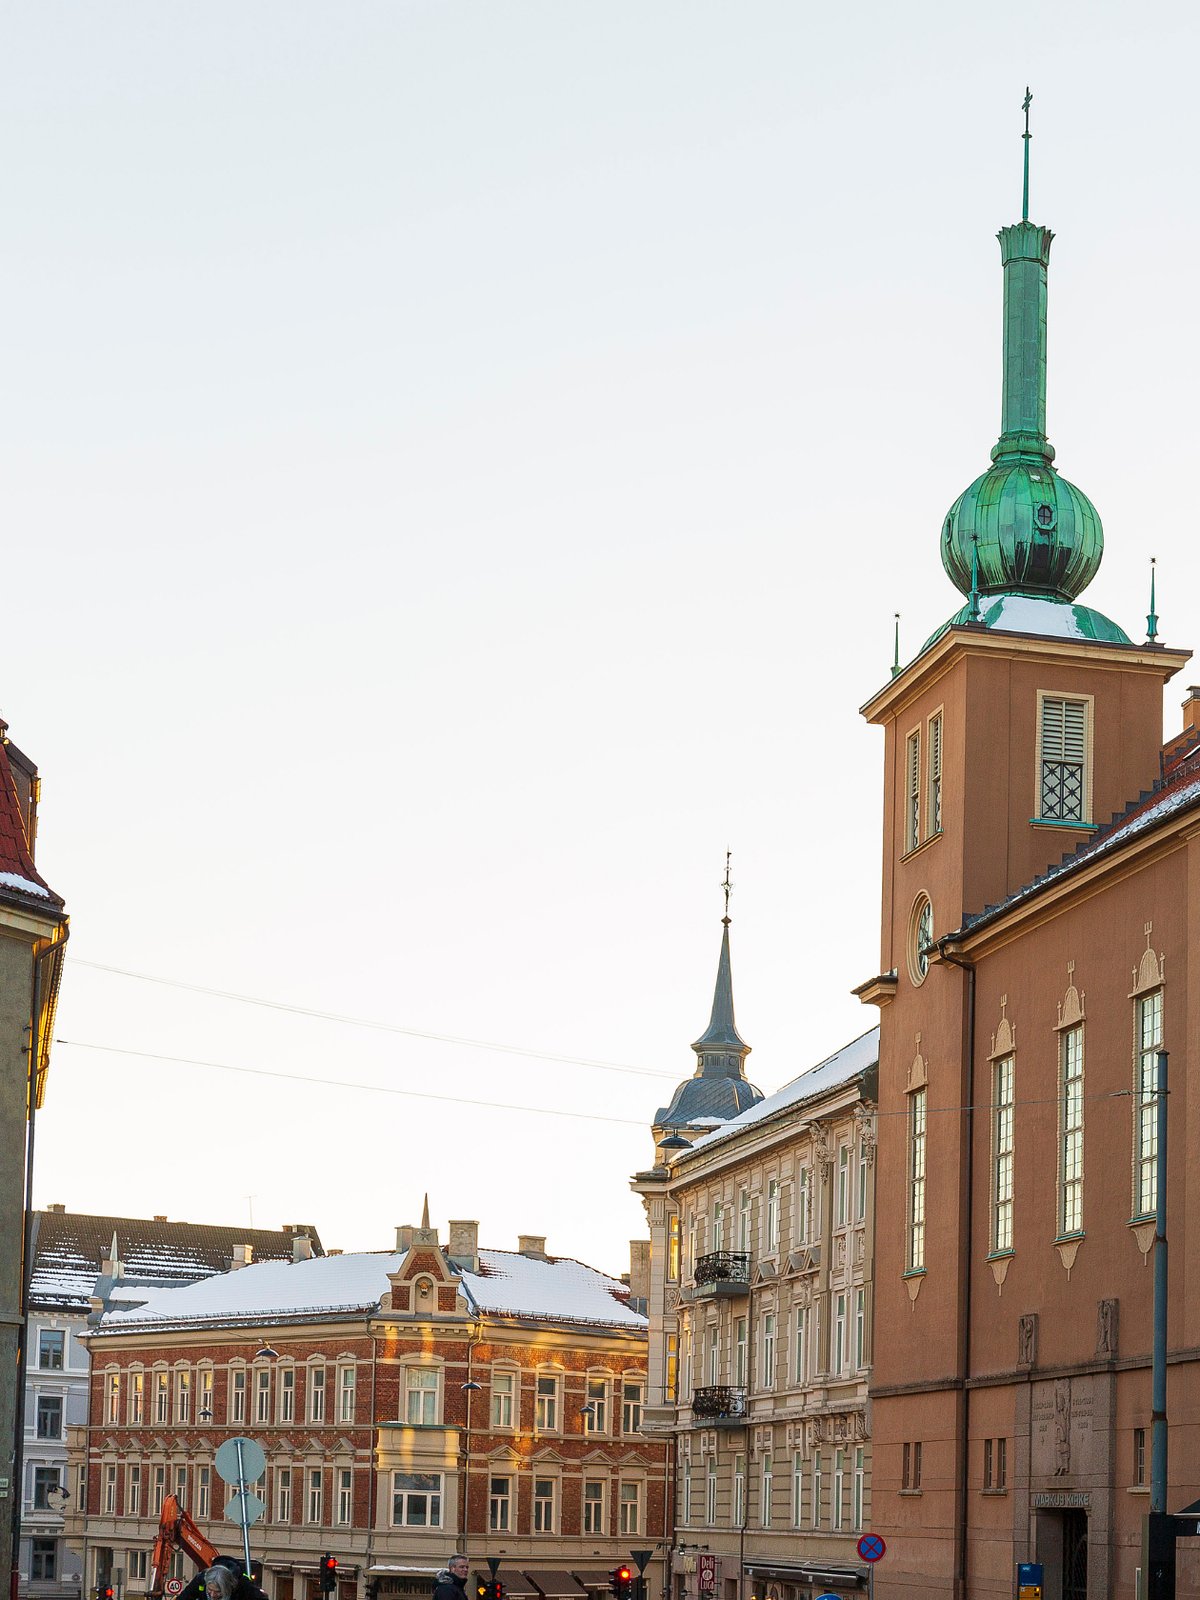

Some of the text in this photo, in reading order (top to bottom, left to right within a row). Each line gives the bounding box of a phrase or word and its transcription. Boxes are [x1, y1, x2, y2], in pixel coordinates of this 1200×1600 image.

[1034, 1493, 1089, 1506] MARKUS KIRKE
[701, 1556, 714, 1569] Deli
[170, 1582, 180, 1591] 40
[377, 1581, 434, 1595] Kaffebrenn
[700, 1577, 714, 1590] Luca
